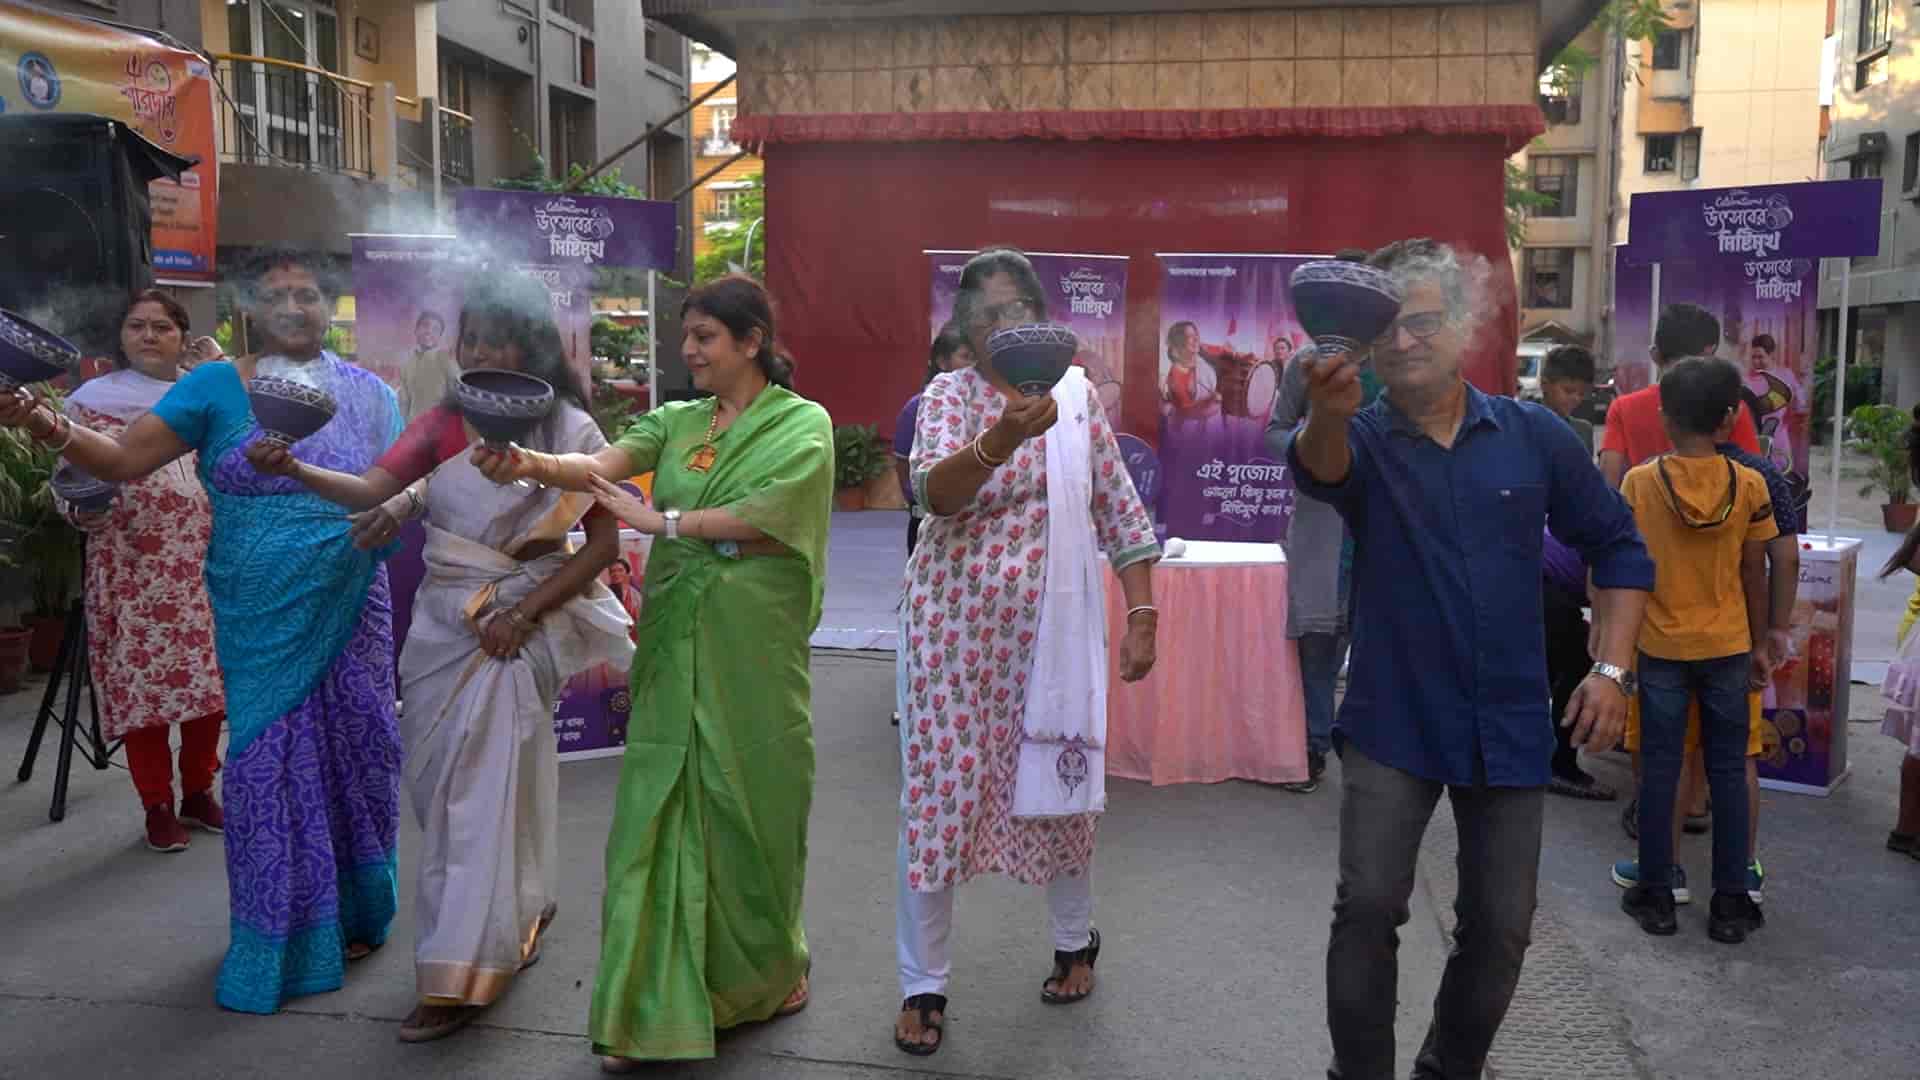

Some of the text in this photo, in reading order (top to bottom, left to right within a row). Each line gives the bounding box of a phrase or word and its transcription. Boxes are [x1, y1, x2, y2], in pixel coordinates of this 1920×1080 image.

[535, 207, 595, 235] উৎসবের
[1703, 203, 1768, 230] উৎসবের
[550, 234, 606, 264] মিষ্টিমুখ
[1718, 228, 1781, 257] মিষ্টিমুখ
[1196, 459, 1286, 484] এই পুজোয়
